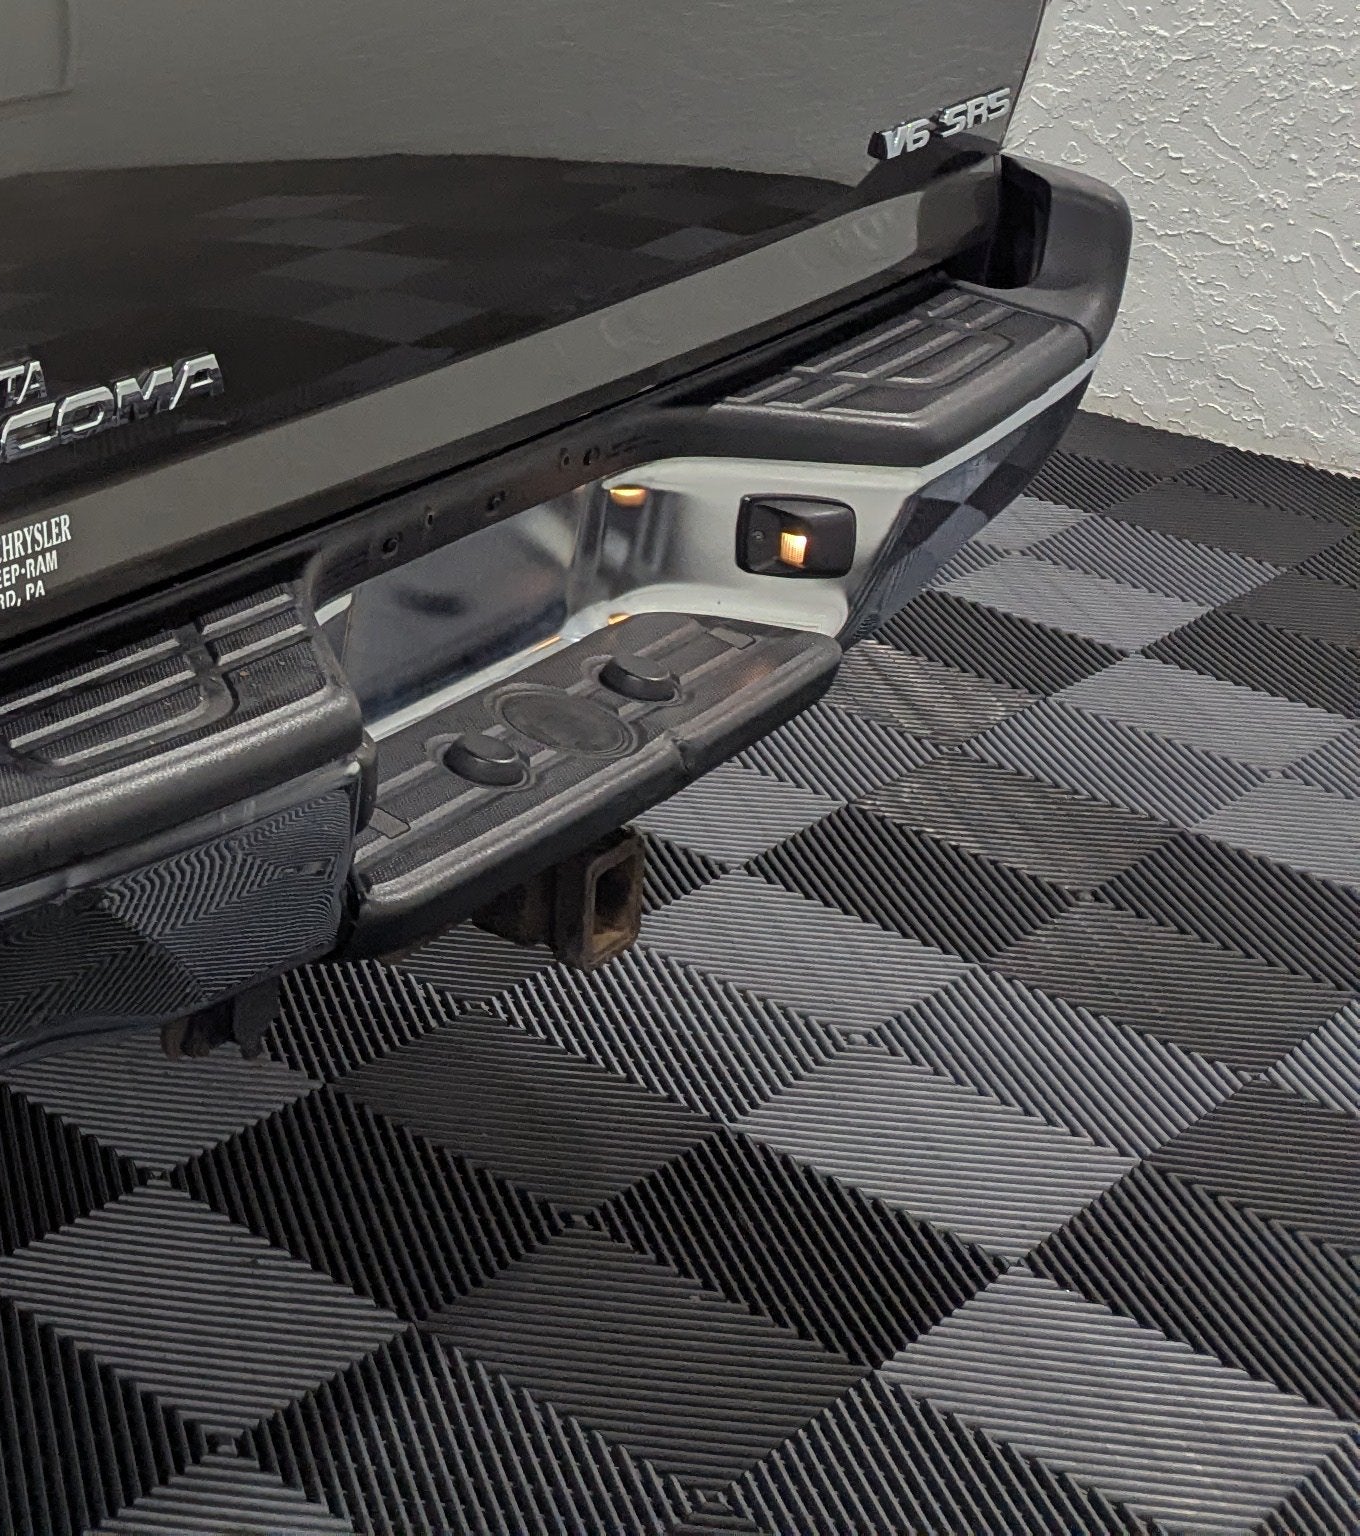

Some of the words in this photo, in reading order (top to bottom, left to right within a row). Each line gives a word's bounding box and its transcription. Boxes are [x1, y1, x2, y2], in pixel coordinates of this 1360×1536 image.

[938, 86, 1012, 138] SR5
[879, 117, 931, 160] V6
[25, 579, 46, 601] PA
